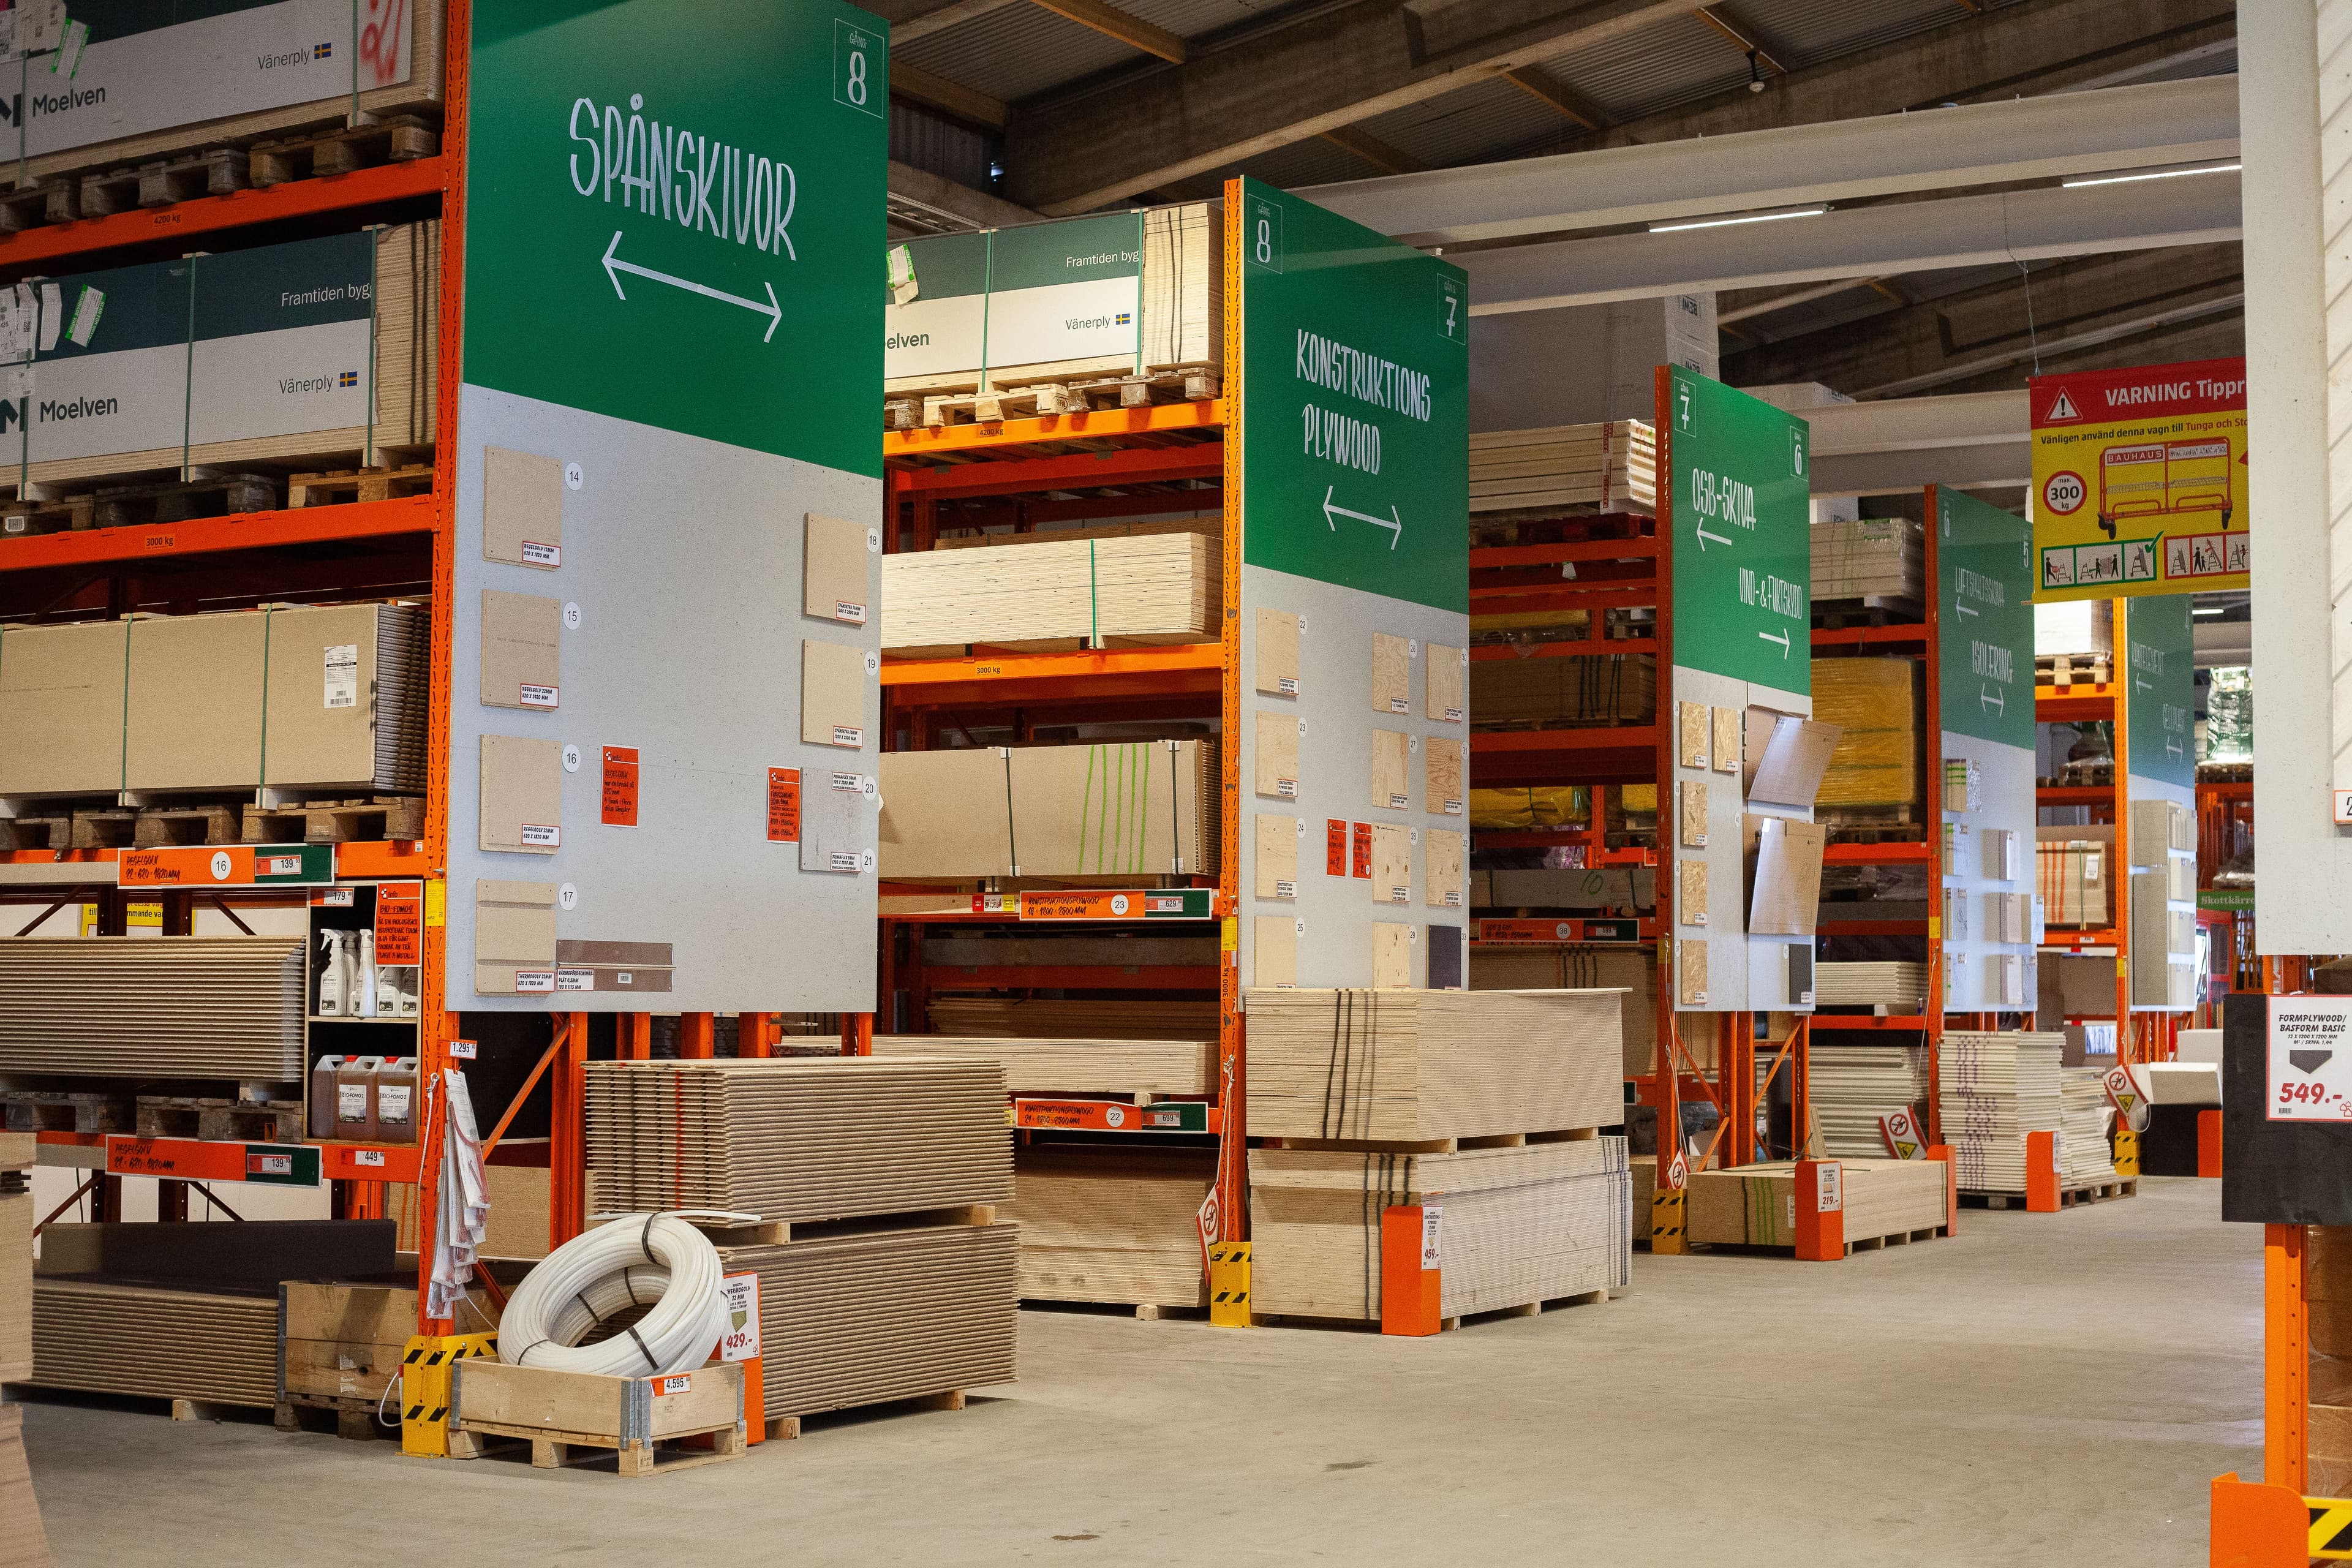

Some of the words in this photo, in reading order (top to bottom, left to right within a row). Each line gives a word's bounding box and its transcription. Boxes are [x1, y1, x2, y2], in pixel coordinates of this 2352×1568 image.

[849, 31, 867, 48] GÅNG
[257, 48, 310, 70] Vänerply
[848, 51, 866, 105] 8
[32, 87, 105, 117] Moelven
[570, 93, 796, 261] SPÅNSKIVOR
[154, 214, 171, 224] 4200
[172, 213, 181, 224] kg
[1256, 219, 1271, 263] 8
[1066, 252, 1117, 268] Framtiden
[281, 287, 344, 307] Framtiden
[347, 283, 371, 300] byg
[1445, 296, 1457, 336] 7
[1065, 315, 1111, 331] Vänerply
[885, 333, 929, 350] elven
[1297, 329, 1431, 422] KONSTRUKTIONS
[279, 375, 333, 395] Vänerply
[2105, 382, 2191, 407] VARNING
[40, 396, 118, 423] Moelven
[1680, 395, 1689, 429] 7
[979, 428, 993, 437] 4200
[993, 428, 1004, 437] kg
[2041, 433, 2079, 445] Vänligen
[2082, 430, 2114, 441] använd
[2117, 427, 2144, 438] denna
[2147, 426, 2169, 437] vagn
[2172, 423, 2184, 434] till
[2186, 421, 2214, 432] Tunga
[2217, 419, 2233, 429] och
[1302, 404, 1381, 475] PLYWOOD
[1795, 444, 1802, 475] 6
[2107, 450, 2163, 464] BAUHAUS
[570, 471, 579, 482] 14
[1692, 467, 1757, 531] OSB-SKIVA
[2051, 486, 2079, 500] 300
[2061, 502, 2070, 511] kg
[1944, 510, 1950, 537] 6
[146, 537, 162, 546] 3000
[164, 536, 173, 547] kg
[869, 535, 876, 545] 18
[2023, 548, 2029, 568] 5
[1739, 567, 1760, 606] VIND-
[1760, 580, 1767, 608] &
[1768, 575, 1803, 619] FUKTSKYDD
[568, 611, 577, 622] 15
[867, 658, 875, 669] 19
[1461, 653, 1468, 662] 30
[1972, 640, 2013, 684] ISOLERING
[992, 666, 1001, 675] kg
[567, 753, 576, 764] 16
[865, 784, 873, 793] 20
[1298, 824, 1304, 832] 24
[1411, 832, 1417, 840] 28
[216, 861, 226, 871] 16
[281, 859, 293, 869] 139
[864, 856, 872, 865] 21
[333, 891, 345, 900] 179
[564, 891, 573, 902] 17
[1223, 967, 1230, 977] kg
[2278, 1014, 2347, 1023] FORMPLYWOOD/
[453, 1042, 470, 1053] 1.295
[2279, 1083, 2343, 1105] 549.-
[271, 1158, 284, 1167] 139
[365, 1152, 377, 1161] 449
[1823, 1196, 1838, 1205] 219.-
[1425, 1248, 1439, 1259] 459.-
[727, 1286, 750, 1294] HERMOGOLV
[726, 1333, 752, 1349] 429.-
[666, 1378, 684, 1389] 4.595
